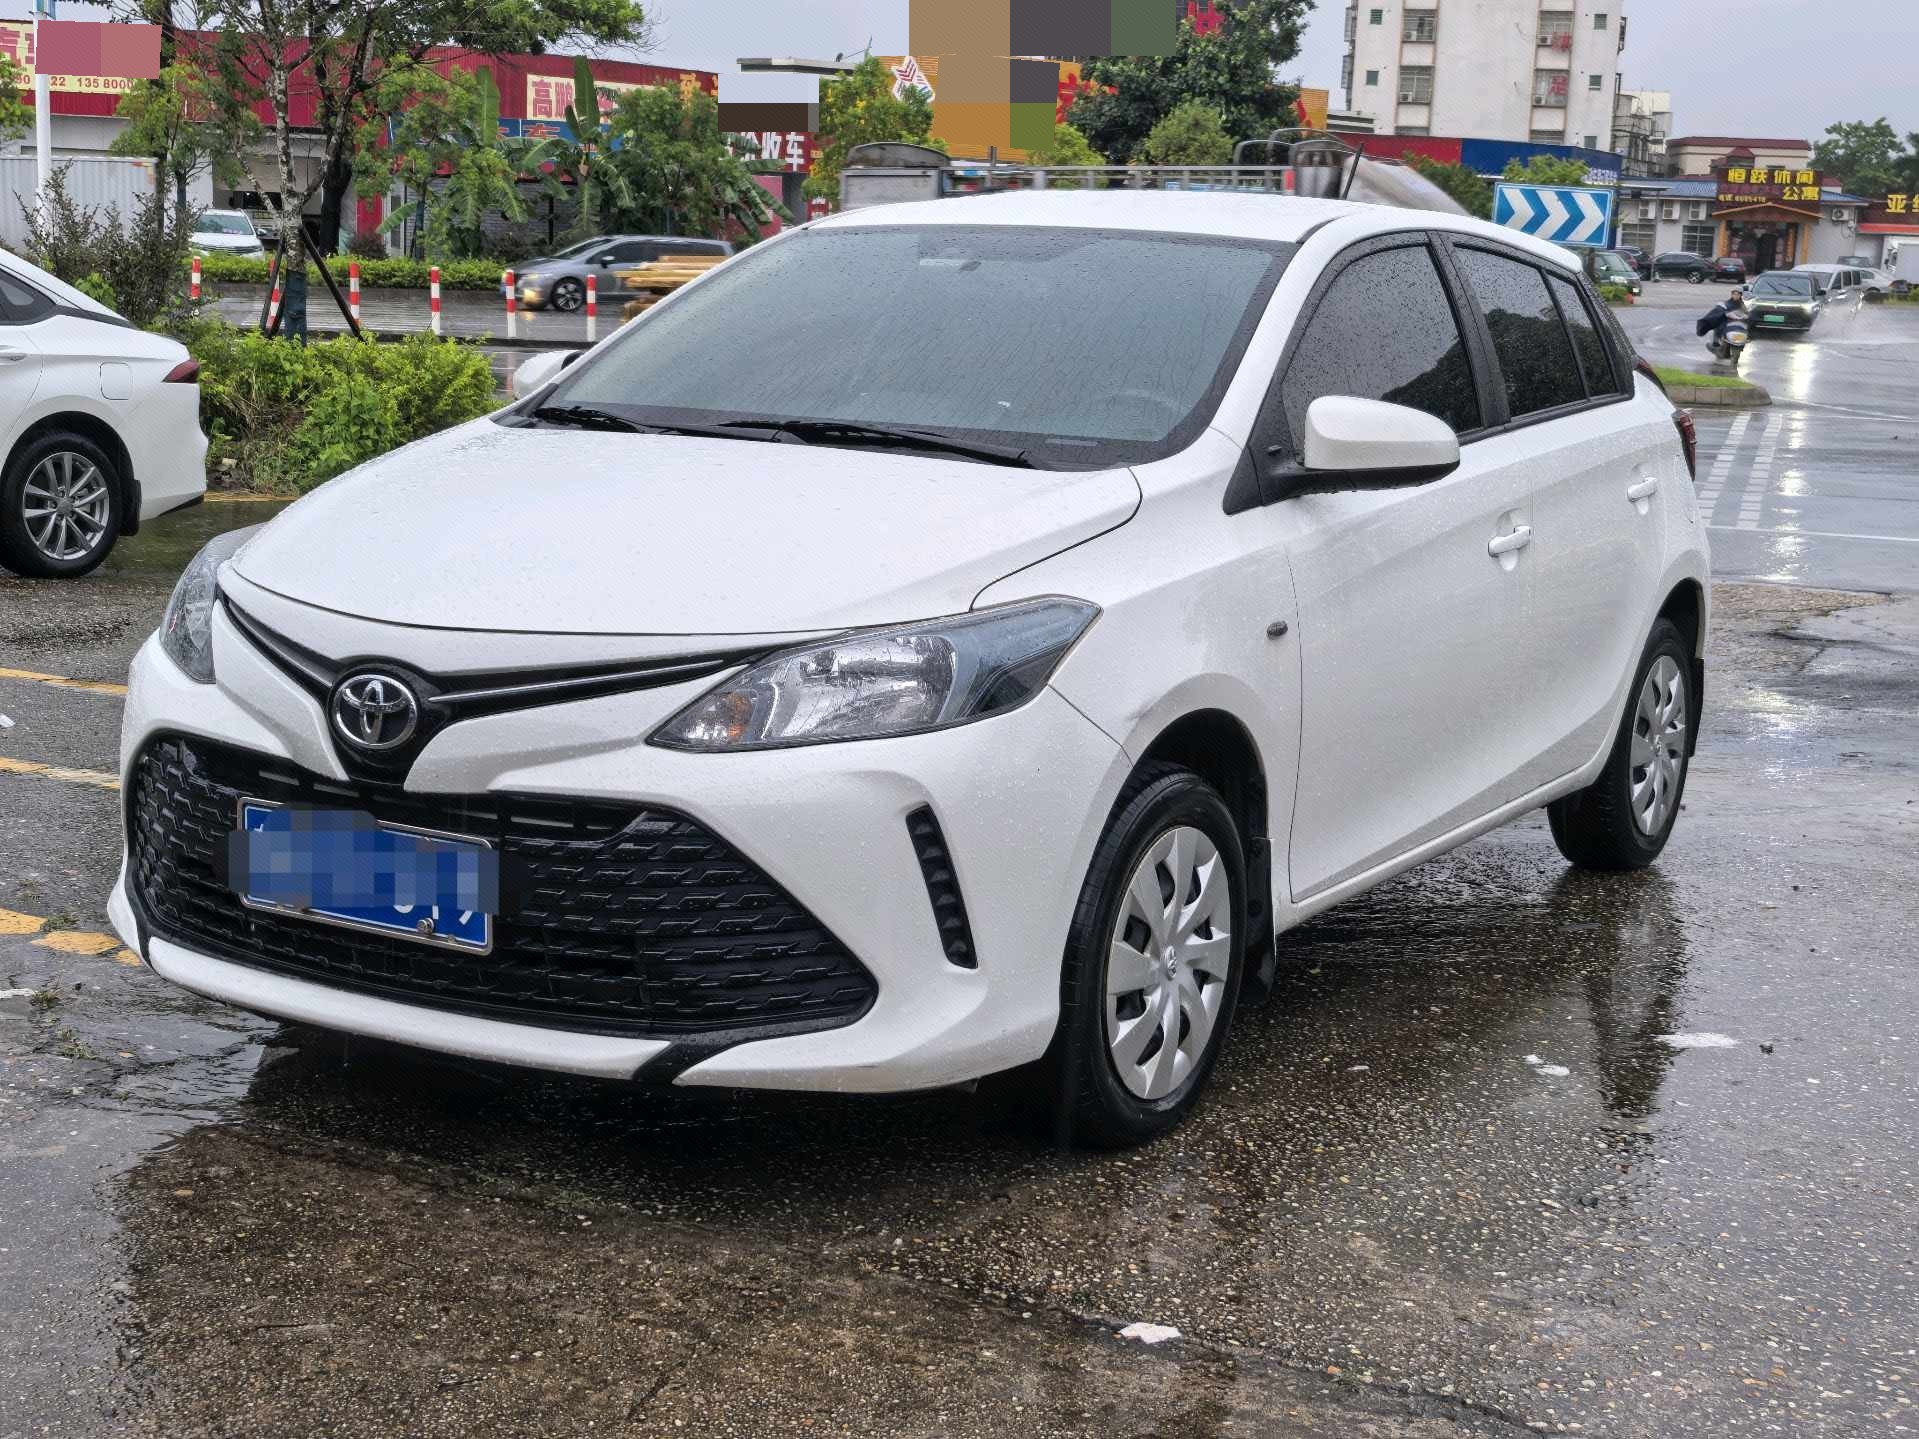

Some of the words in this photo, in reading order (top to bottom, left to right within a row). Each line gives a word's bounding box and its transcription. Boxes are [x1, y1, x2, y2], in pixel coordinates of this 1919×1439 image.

[50, 76, 66, 87] 22
[77, 77, 99, 89] 135
[1782, 186, 1820, 201] 公寓
